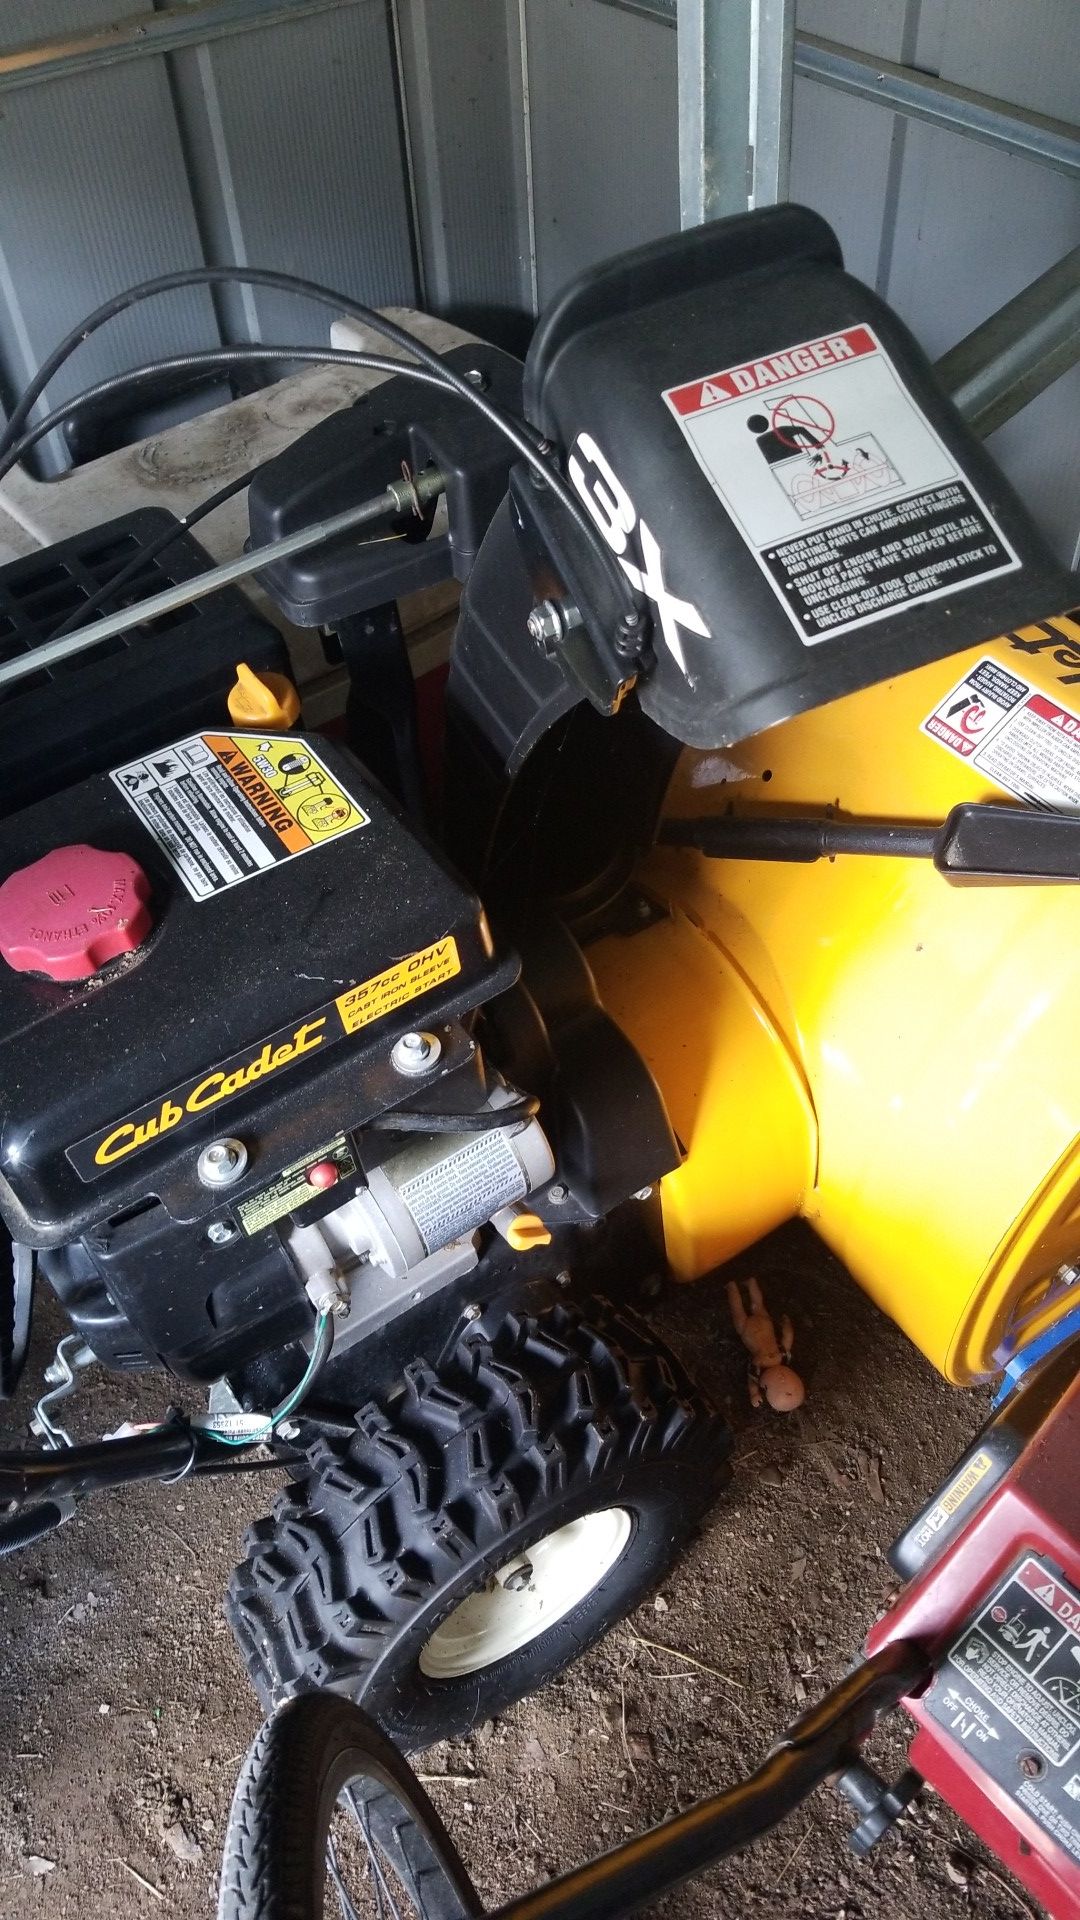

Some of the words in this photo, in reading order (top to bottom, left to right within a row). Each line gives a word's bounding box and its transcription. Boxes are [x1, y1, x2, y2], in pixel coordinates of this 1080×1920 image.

[728, 335, 855, 394] DANGER
[775, 539, 807, 557] NEVER
[805, 532, 826, 546] PUT
[825, 523, 852, 539] HAND
[851, 519, 864, 530] IN
[862, 507, 896, 526] CHUTE.
[895, 493, 936, 514] CONTACT
[935, 484, 960, 499] WITH
[779, 542, 828, 566] ROTATING
[827, 531, 860, 549] PARTS
[858, 524, 879, 538] CAN
[878, 507, 927, 531] AMPUTATE
[926, 493, 966, 513] FINGERS
[568, 432, 712, 692] 3X
[785, 560, 807, 575] AND
[806, 548, 843, 567] HANDS.
[793, 570, 822, 587] SHUT
[821, 562, 843, 577] OFF
[842, 549, 881, 569] ENGINE
[880, 541, 903, 555] AND
[902, 531, 929, 547] WAIT
[928, 521, 959, 537] UNTIL
[958, 513, 978, 527] ALL
[798, 574, 840, 596] MOVING
[839, 562, 874, 581] PARTS
[873, 552, 901, 569] HAVE
[900, 536, 946, 559] STOPPED
[945, 522, 984, 542] BEFORE
[803, 574, 870, 606] UNCLOGGING.
[810, 604, 831, 618] USE
[829, 586, 880, 611] CLEAN-OUT
[879, 577, 904, 593] TOOL
[903, 571, 920, 584] OR
[917, 557, 957, 579] WOODEN
[955, 547, 984, 565] STICK
[982, 543, 997, 555] TO
[815, 606, 856, 628] UNCLOG
[854, 586, 909, 613] DISCHARGE
[906, 574, 942, 594] CHUTE.
[926, 717, 960, 748] DANGER
[251, 753, 278, 778] 5W30
[230, 762, 293, 833] WARNING
[29, 923, 89, 942] ETHANOL
[344, 972, 400, 1008] 357cc
[407, 942, 448, 972] OHV
[347, 997, 379, 1019] CAST
[380, 982, 407, 1001] IRON
[409, 956, 451, 984] SLEEVE
[351, 992, 410, 1029] ELECTRIC
[414, 968, 453, 994] START
[95, 1099, 183, 1165] Cub
[186, 1017, 327, 1113] Cadet
[943, 1470, 979, 1511] WARNING
[953, 1654, 965, 1668] FOR
[976, 1668, 993, 1685] READ
[990, 1682, 1008, 1699] YOUR
[981, 1662, 995, 1676] NOT
[991, 1651, 1007, 1667] STOP
[1023, 1682, 1034, 1693] TO
[942, 1697, 959, 1711] OFF
[964, 1697, 990, 1722] CHOKE
[1009, 1678, 1019, 1689] OR
[1058, 1726, 1070, 1738] DO
[975, 1729, 990, 1742] ON
